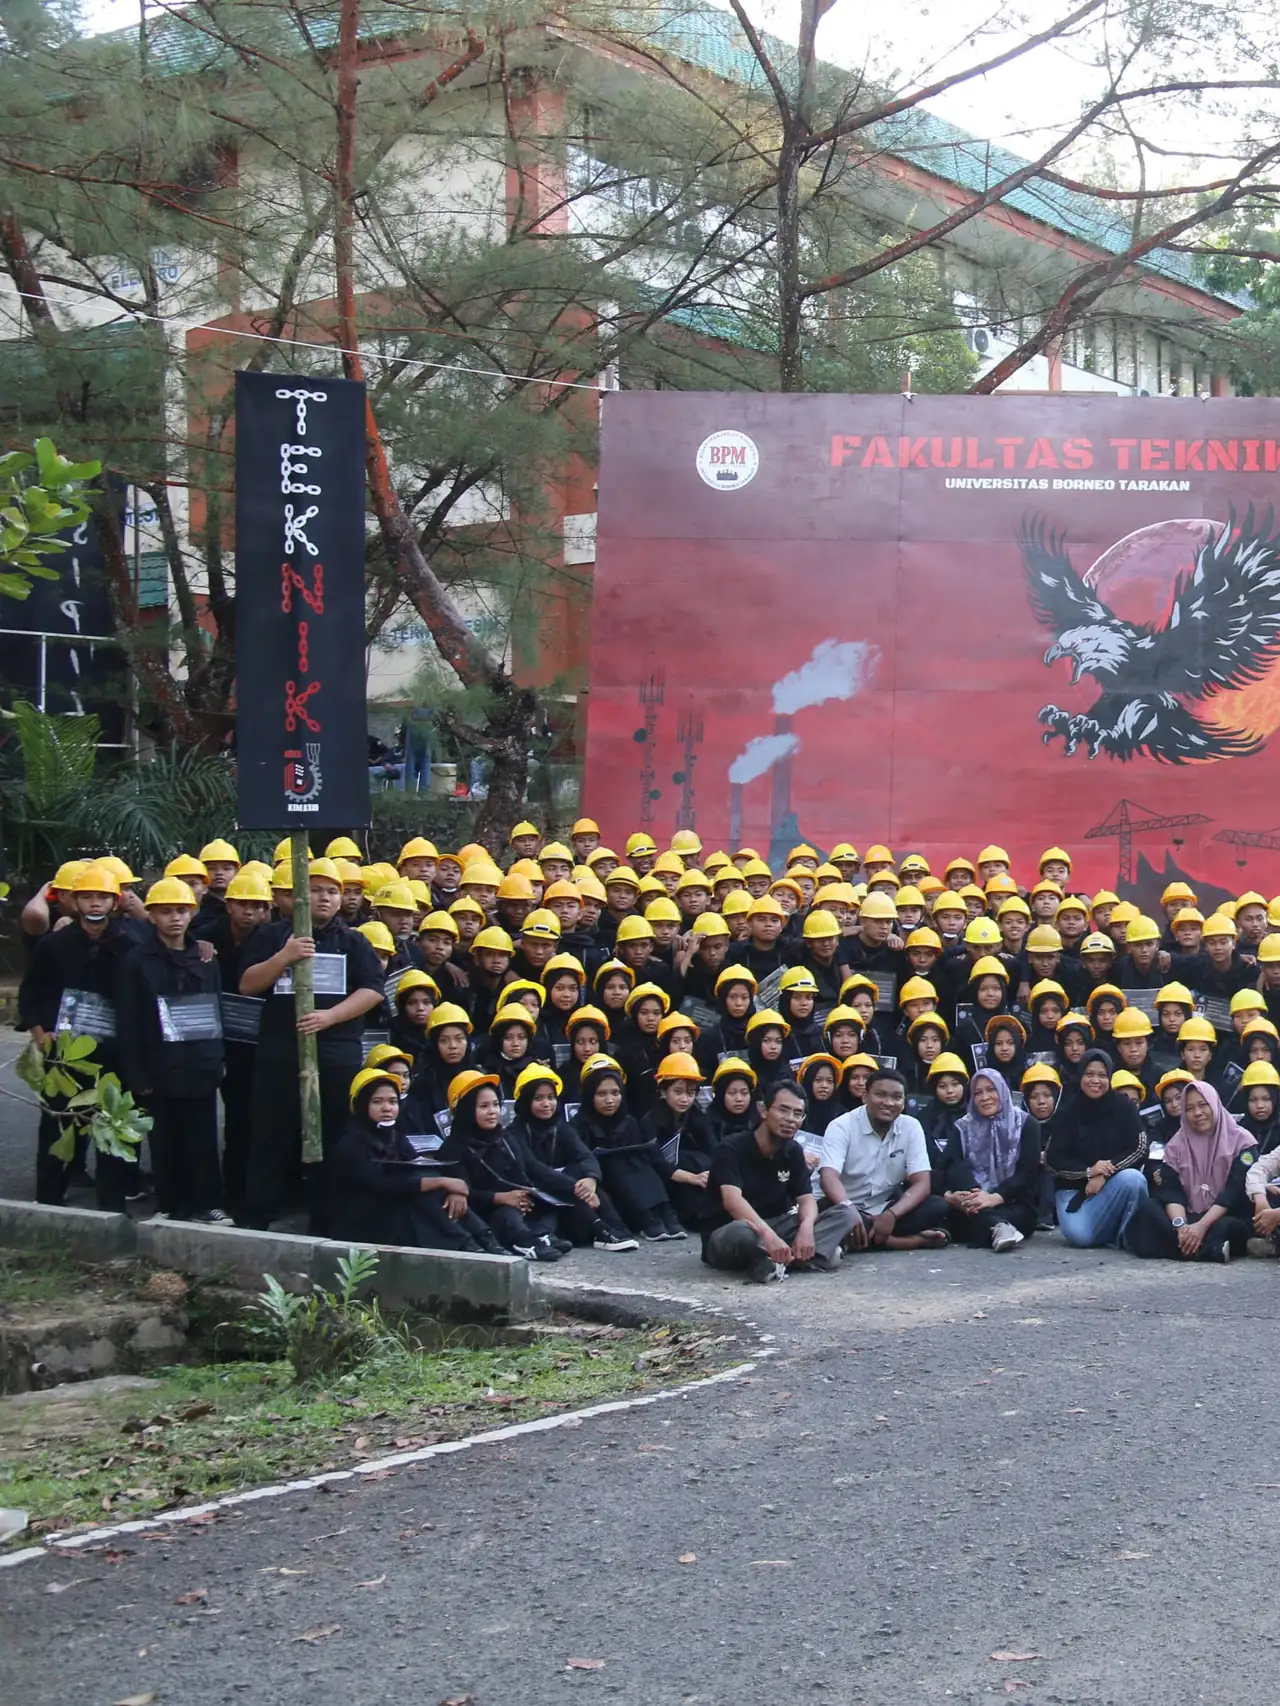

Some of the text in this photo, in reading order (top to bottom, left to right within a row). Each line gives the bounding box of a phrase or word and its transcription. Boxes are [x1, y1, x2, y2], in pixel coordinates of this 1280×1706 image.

[709, 445, 747, 465] BPM
[830, 434, 1094, 470] FAKULTAS
[945, 477, 1190, 492] UNIVERSITAS BORNEO TARAKAN
